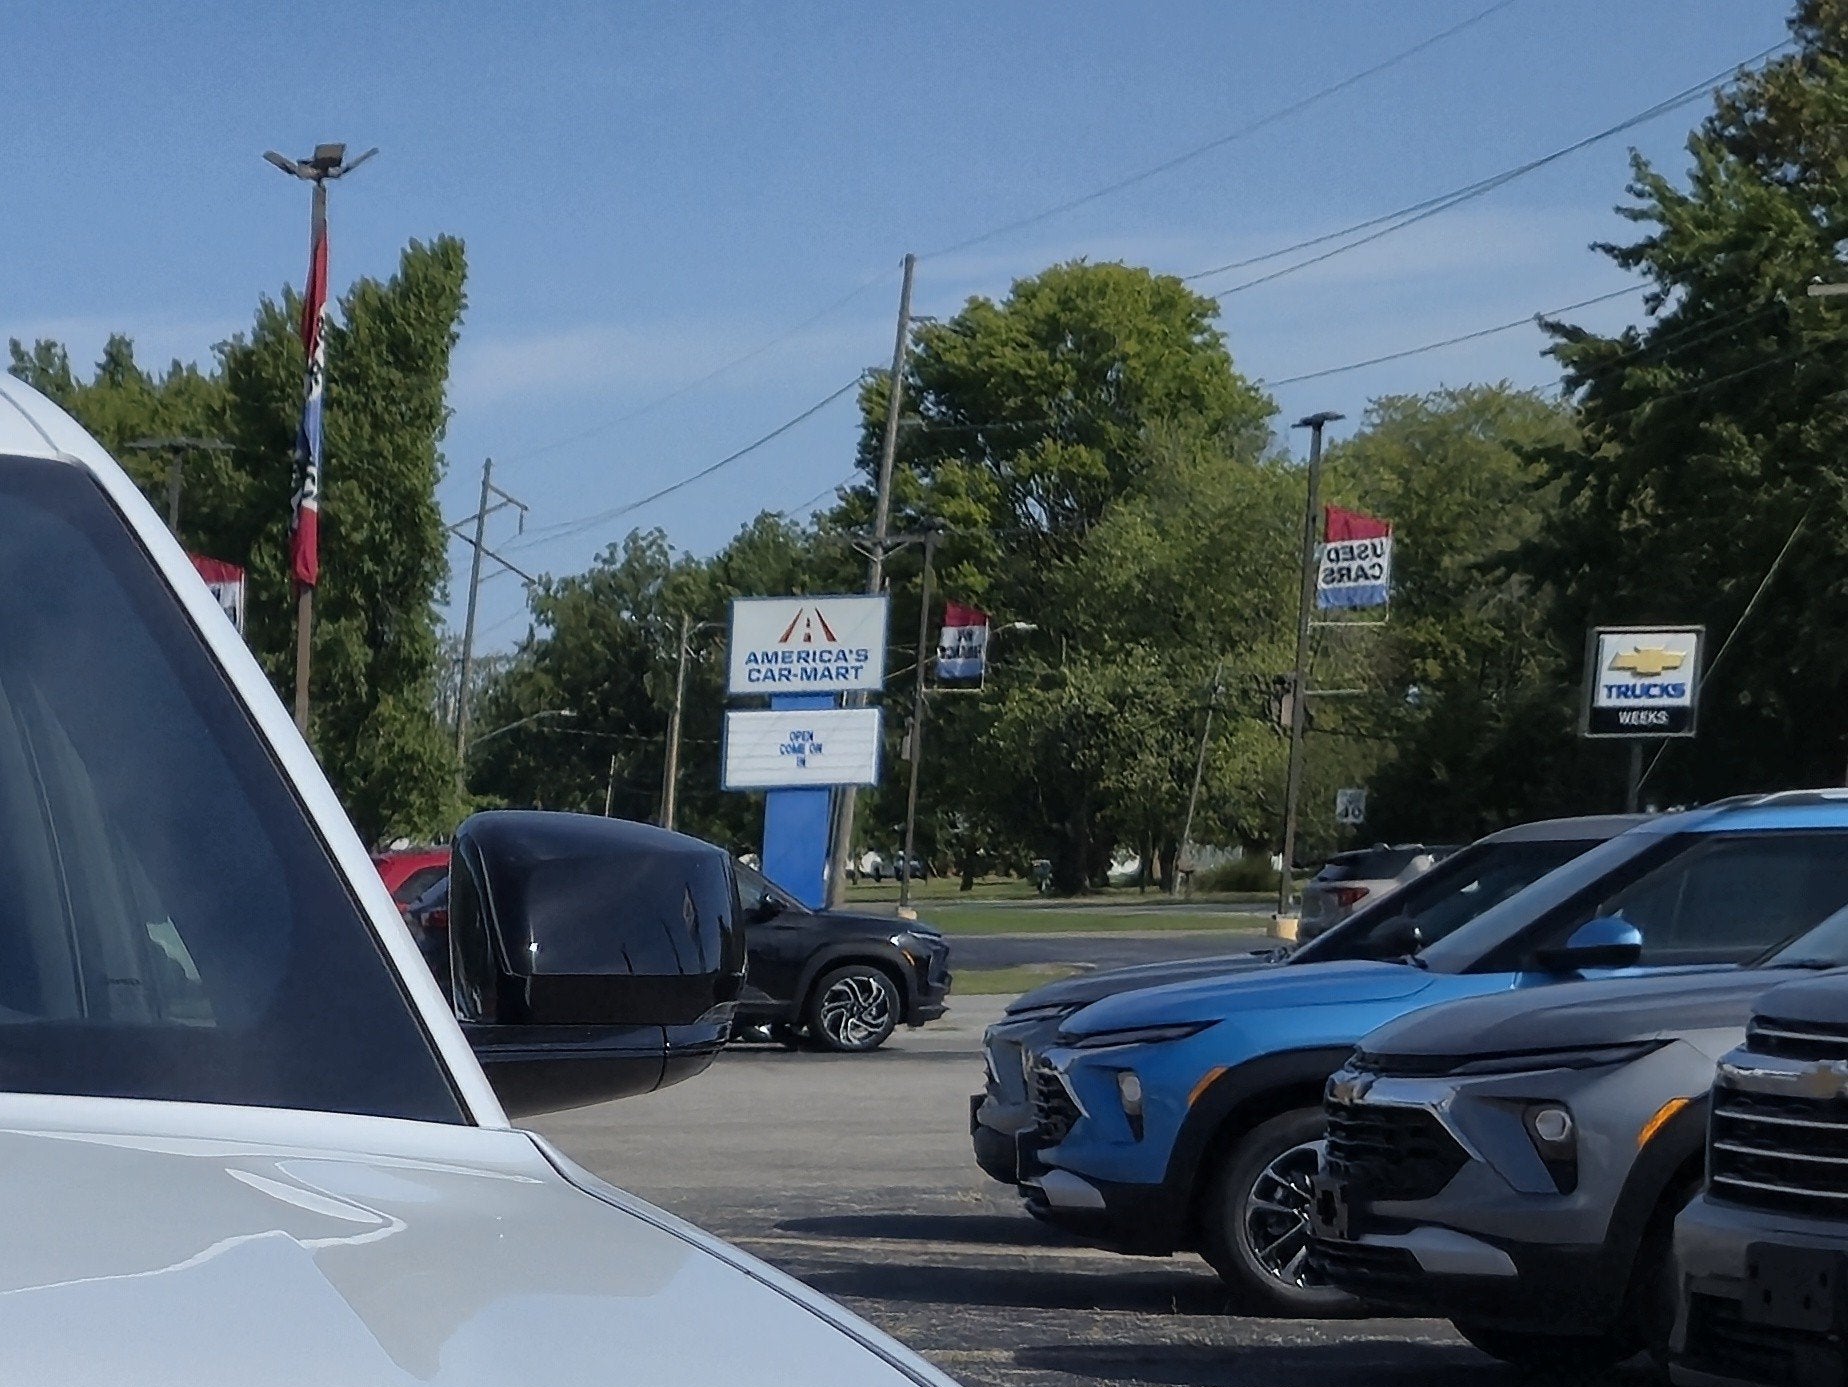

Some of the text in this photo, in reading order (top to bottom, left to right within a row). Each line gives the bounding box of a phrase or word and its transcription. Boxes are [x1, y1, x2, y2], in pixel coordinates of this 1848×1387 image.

[745, 648, 869, 666] AMERICA'S
[747, 665, 864, 683] CAR-MART
[1603, 682, 1686, 699] TRUCKS
[1618, 710, 1669, 726] WEEKS
[789, 730, 814, 743] OPEN
